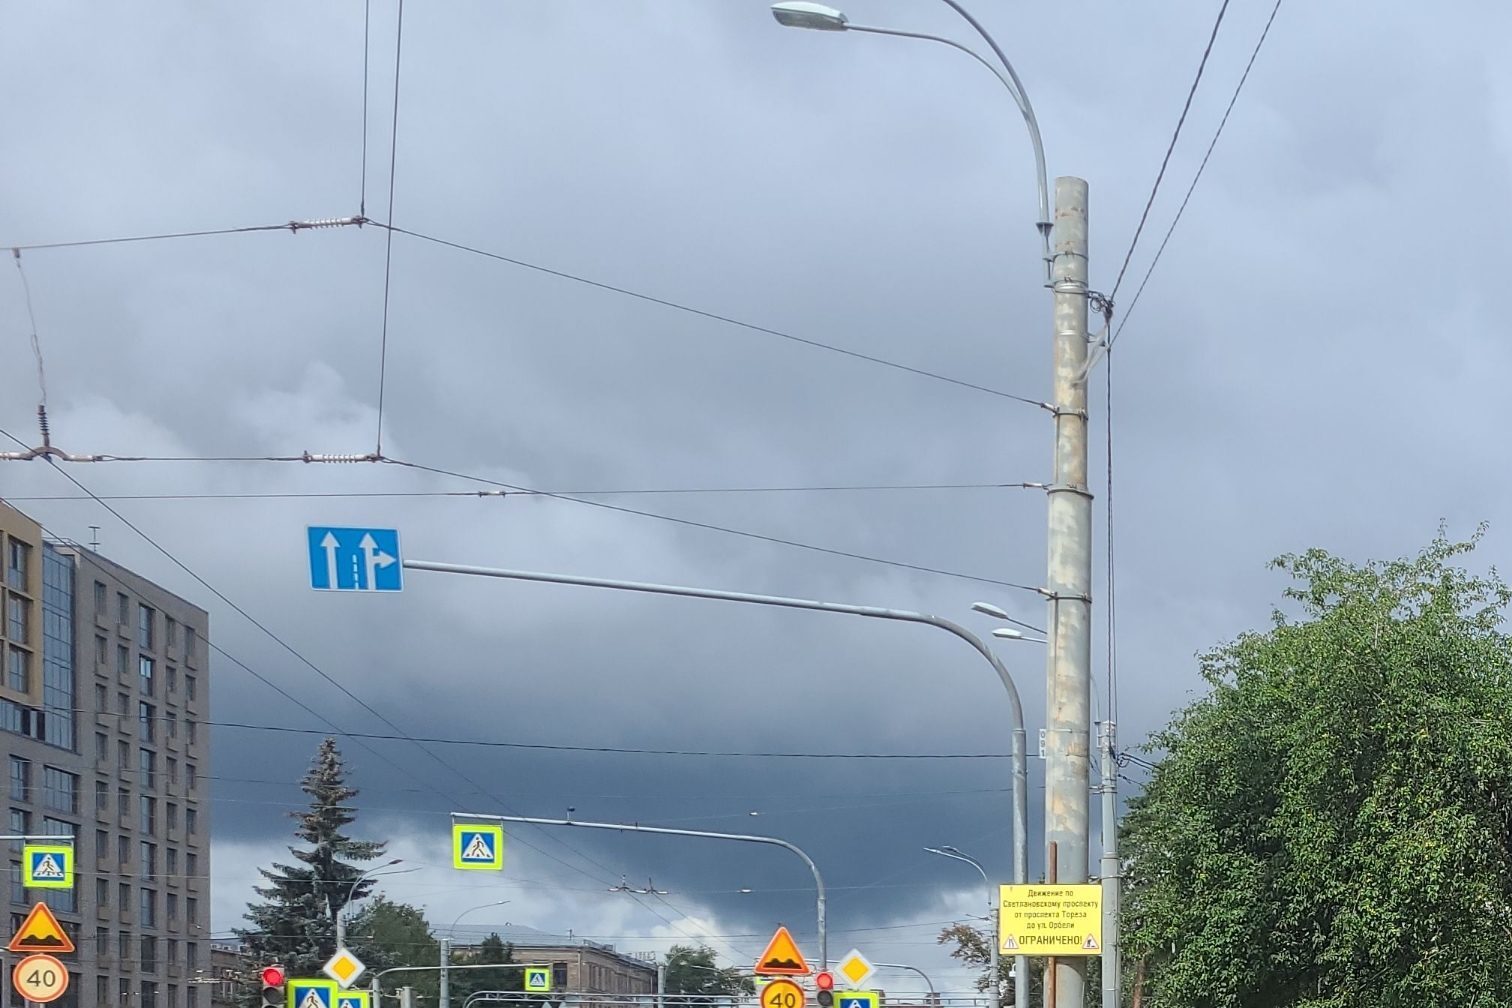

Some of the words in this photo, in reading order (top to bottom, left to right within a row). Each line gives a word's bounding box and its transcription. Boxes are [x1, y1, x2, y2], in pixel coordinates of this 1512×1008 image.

[1027, 889, 1063, 898] Движение
[1003, 900, 1061, 909] Светлановскому
[1024, 911, 1059, 919] проспекта
[1062, 910, 1087, 918] Тореза
[1026, 922, 1035, 930] до
[1049, 921, 1075, 929] Орбели
[1019, 935, 1083, 945] ОГРАНИЧЕНО!
[26, 969, 56, 987] 40
[769, 992, 796, 1008] 40
